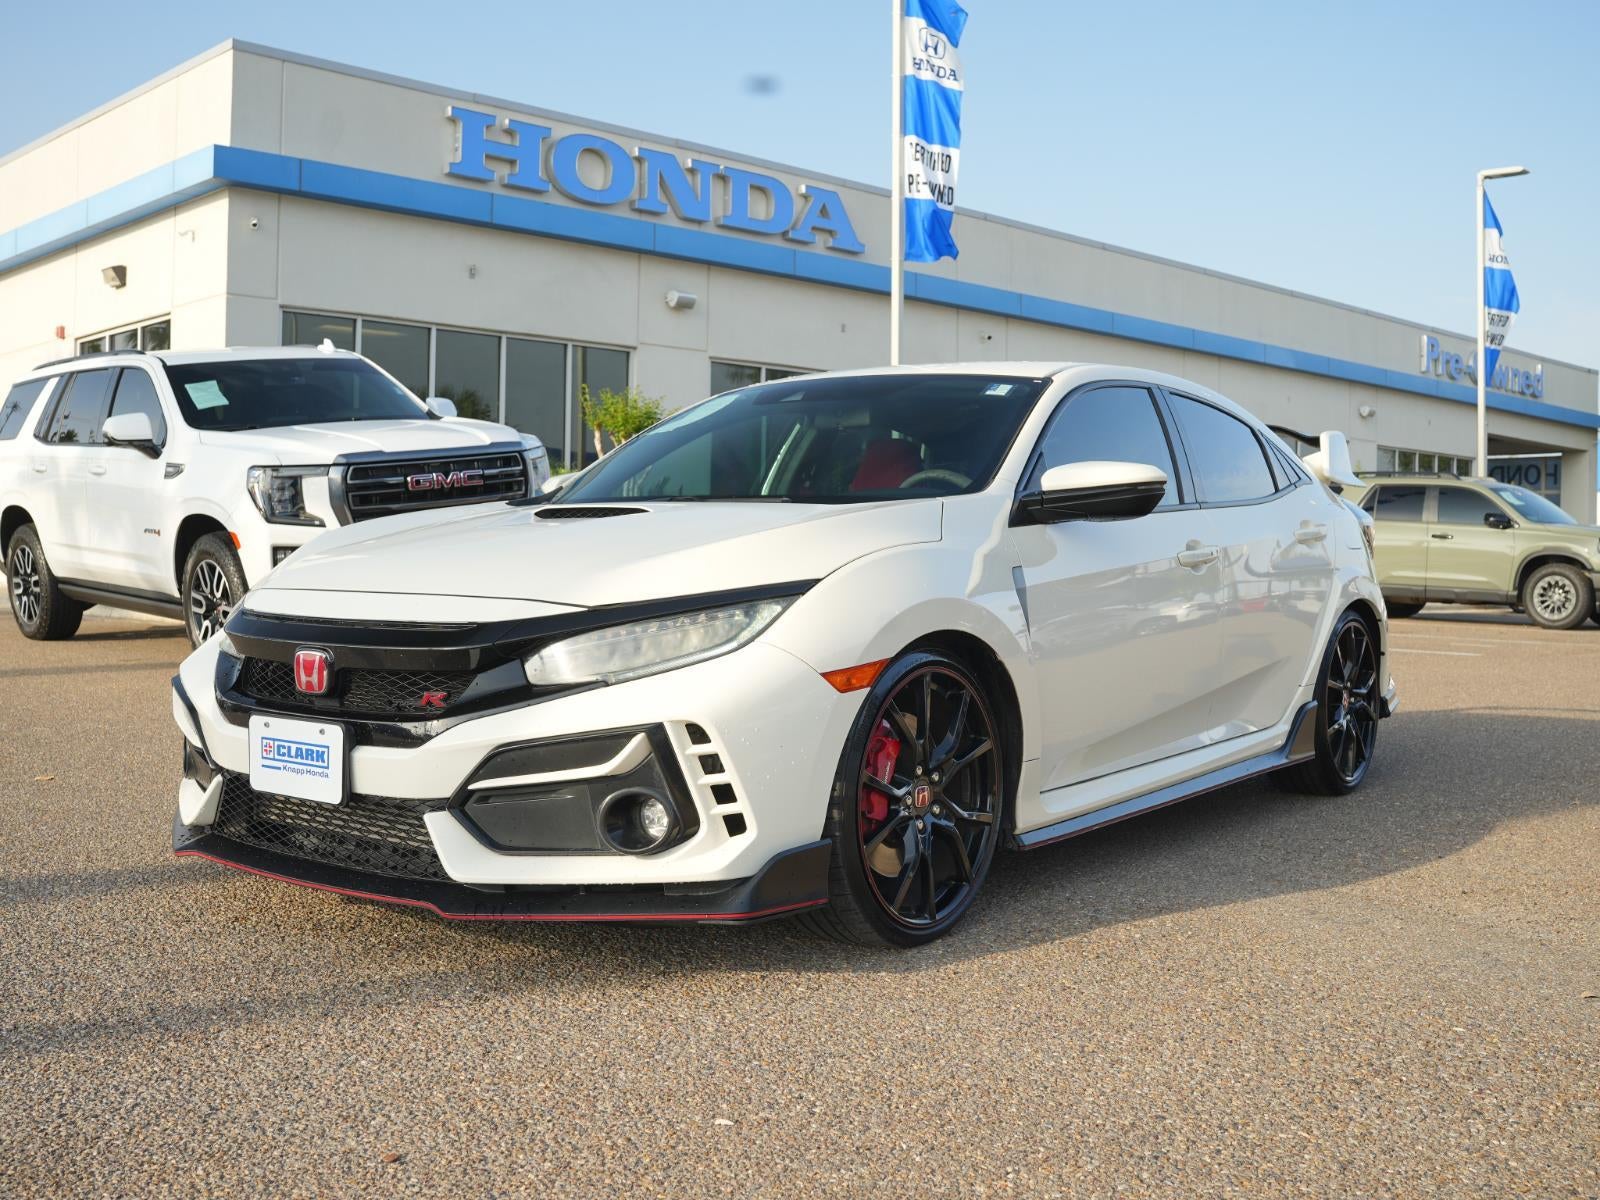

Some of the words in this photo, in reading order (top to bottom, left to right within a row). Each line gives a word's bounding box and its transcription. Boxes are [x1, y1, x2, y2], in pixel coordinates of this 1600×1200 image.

[444, 104, 866, 255] HONDA
[406, 469, 484, 491] GMC
[276, 743, 326, 764] CLARK
[282, 764, 305, 776] Knapp
[305, 770, 330, 779] Honda
